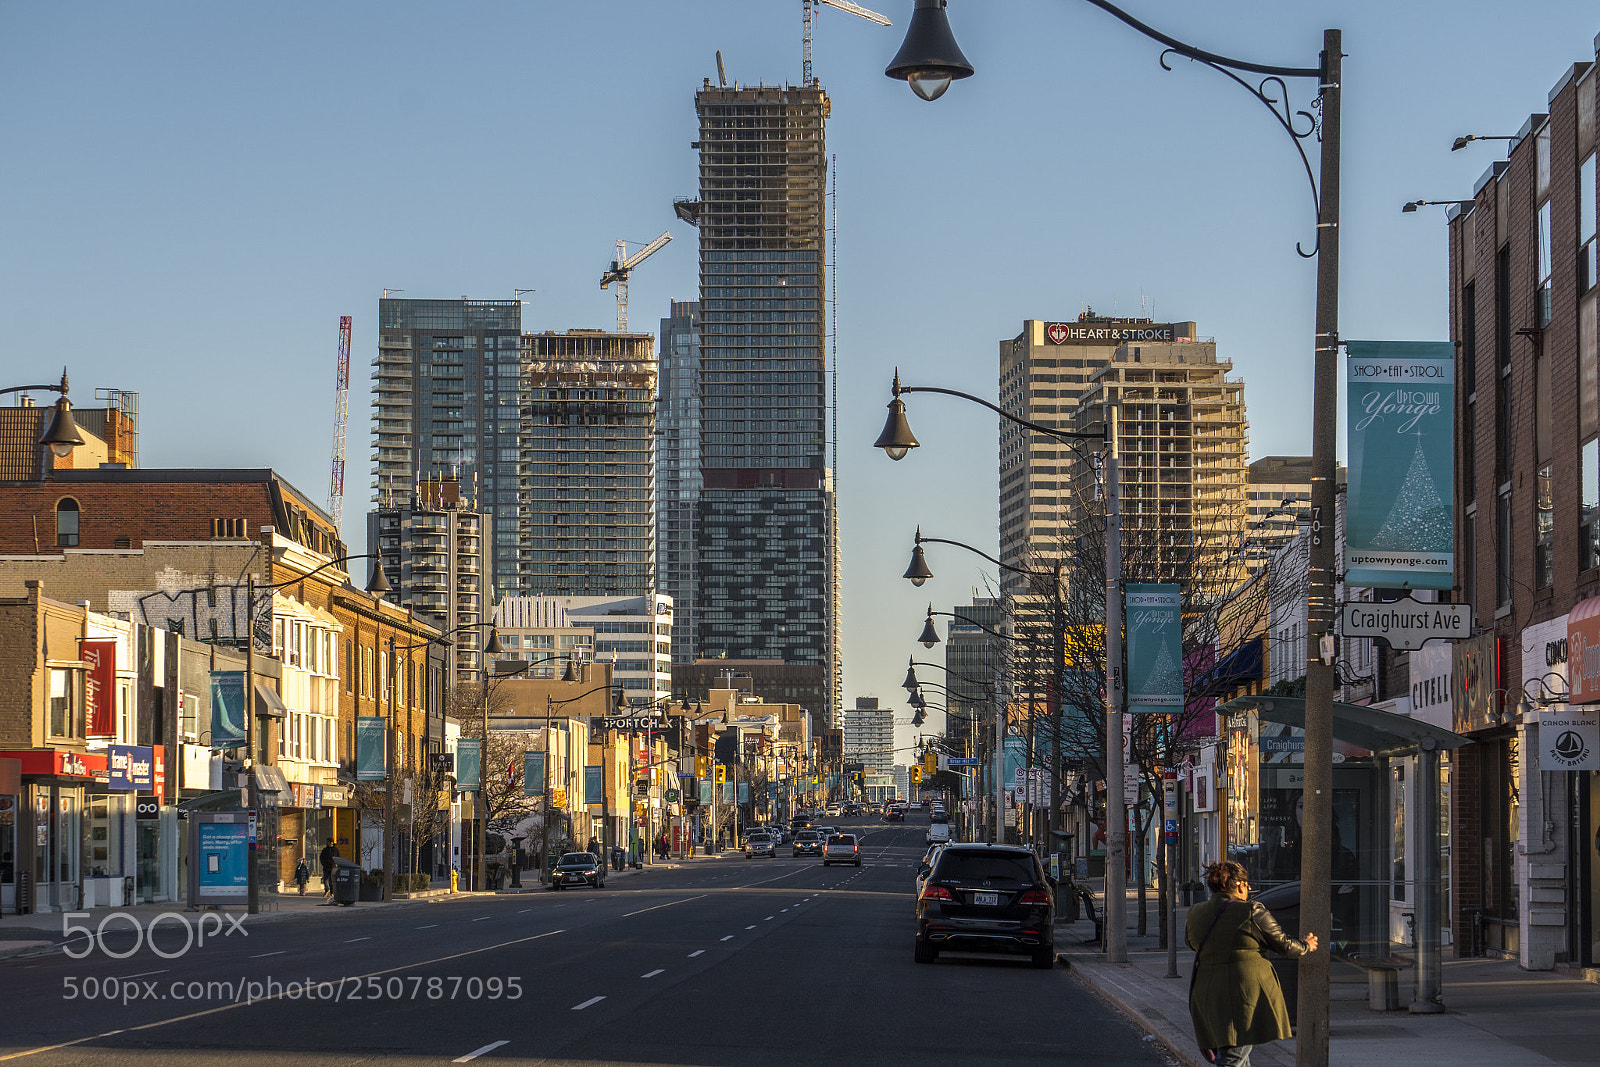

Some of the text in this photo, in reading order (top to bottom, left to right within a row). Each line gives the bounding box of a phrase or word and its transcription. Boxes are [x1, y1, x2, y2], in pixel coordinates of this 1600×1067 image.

[1071, 328, 1110, 339] HEART
[1122, 329, 1171, 340] STROKE
[1354, 365, 1445, 378] SHOP EAT STROLL
[1355, 390, 1442, 434] Yonge
[1312, 507, 1321, 545] 706
[1351, 556, 1448, 567] uptownyonge.com
[1130, 610, 1175, 634] Yonge
[1351, 609, 1461, 633] Craighurst Ave
[1582, 632, 1600, 691] Supp
[1412, 673, 1452, 710] CIVELL
[603, 717, 673, 730] SPORTCHK
[1266, 740, 1304, 752] Craighurs
[111, 749, 128, 770] frame
[132, 759, 150, 776] master
[1550, 748, 1590, 767] PETIT BATEAU
